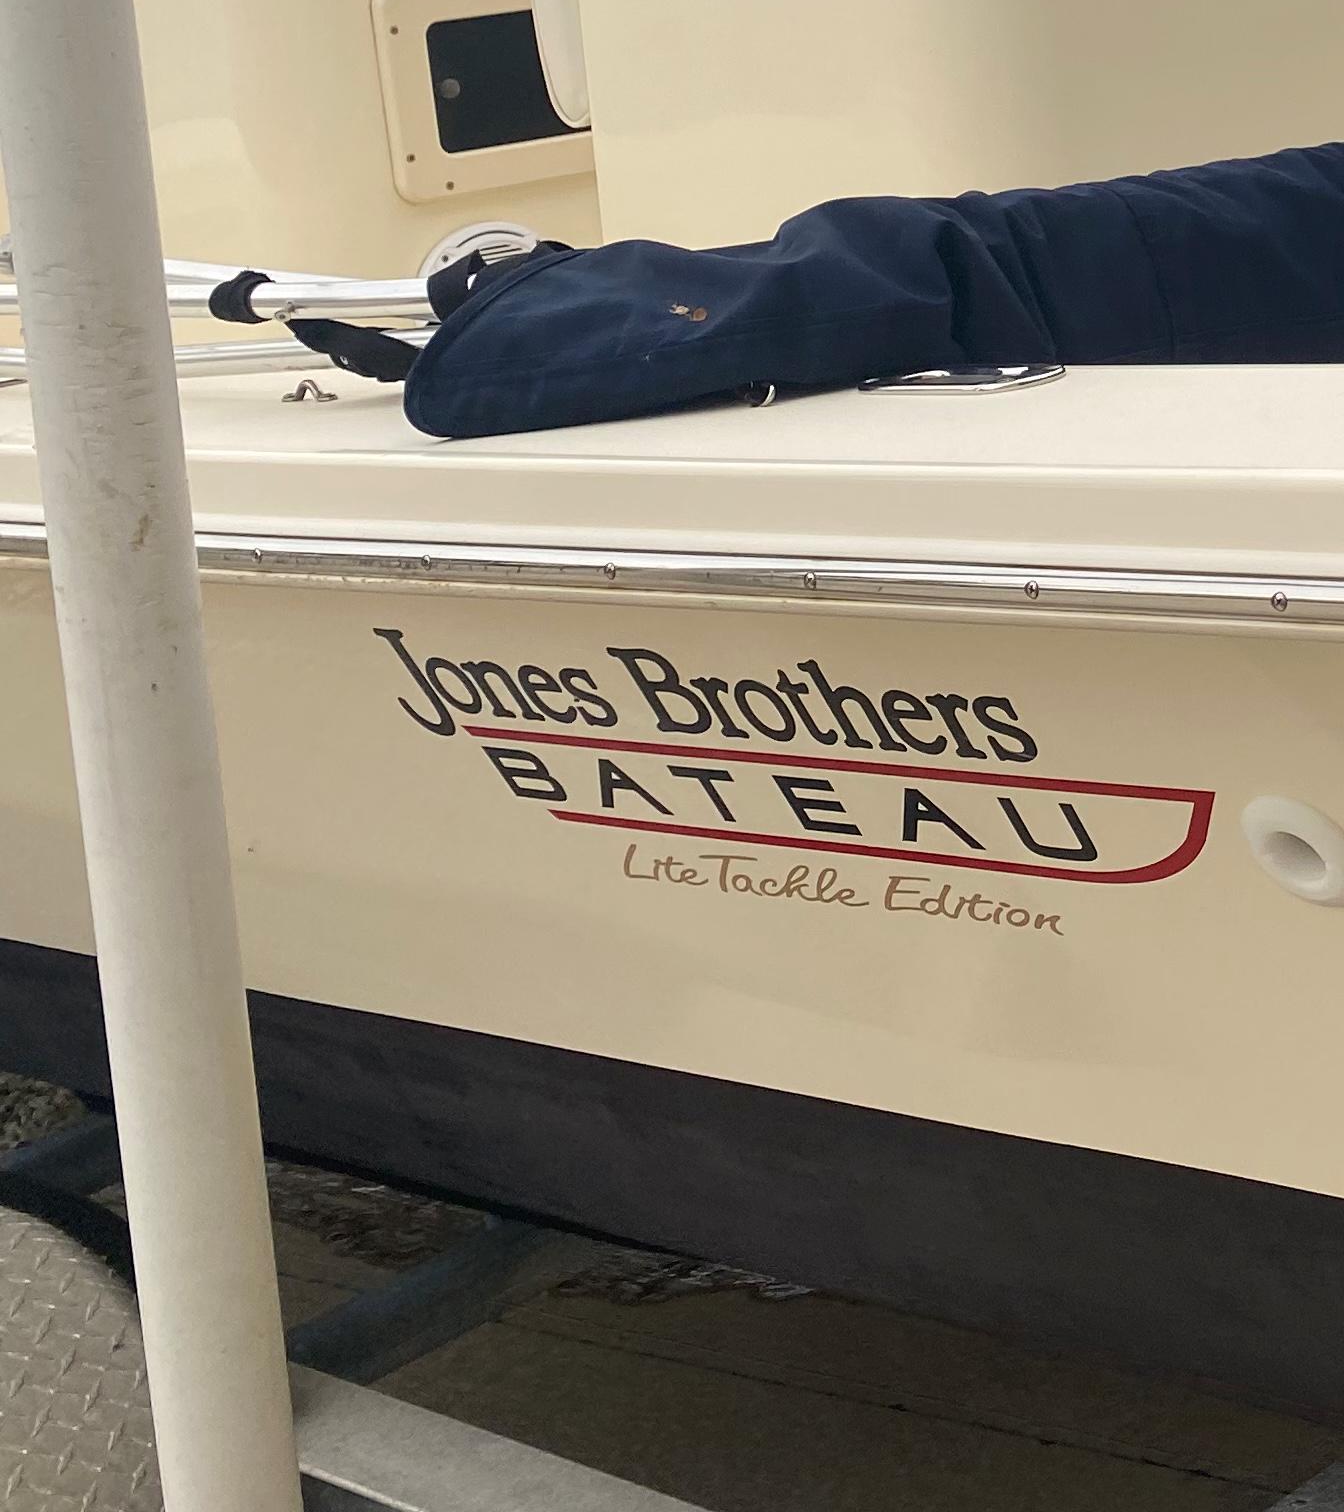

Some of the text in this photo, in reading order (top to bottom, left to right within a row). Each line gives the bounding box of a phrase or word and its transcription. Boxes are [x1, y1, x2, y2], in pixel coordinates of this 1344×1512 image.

[372, 627, 1039, 763] Jones Brothers
[480, 745, 1099, 862] BATEAU
[883, 874, 1065, 936] Edition
